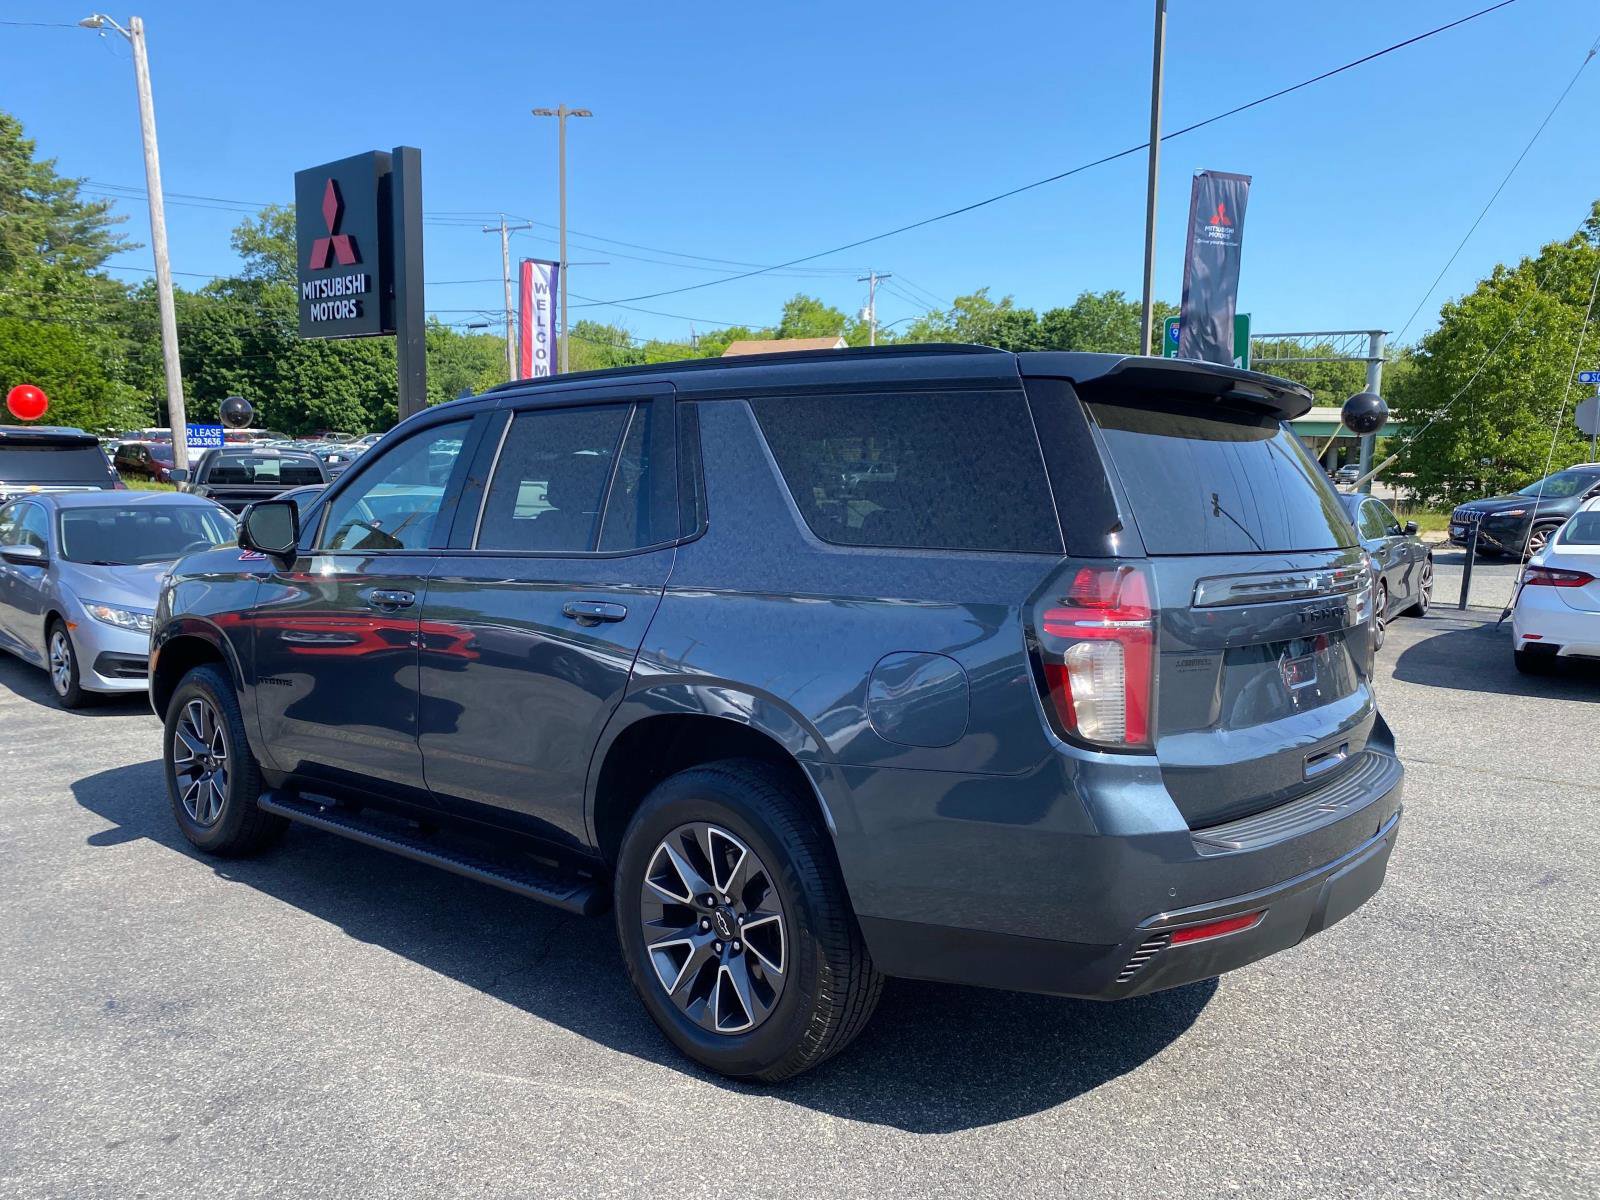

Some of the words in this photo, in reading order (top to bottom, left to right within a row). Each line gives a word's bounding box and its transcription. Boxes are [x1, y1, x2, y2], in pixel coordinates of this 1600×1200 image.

[302, 273, 365, 300] MITSUBISHI
[310, 298, 357, 322] MOTORS
[534, 282, 548, 377] WELCOM
[194, 428, 221, 437] LEASE
